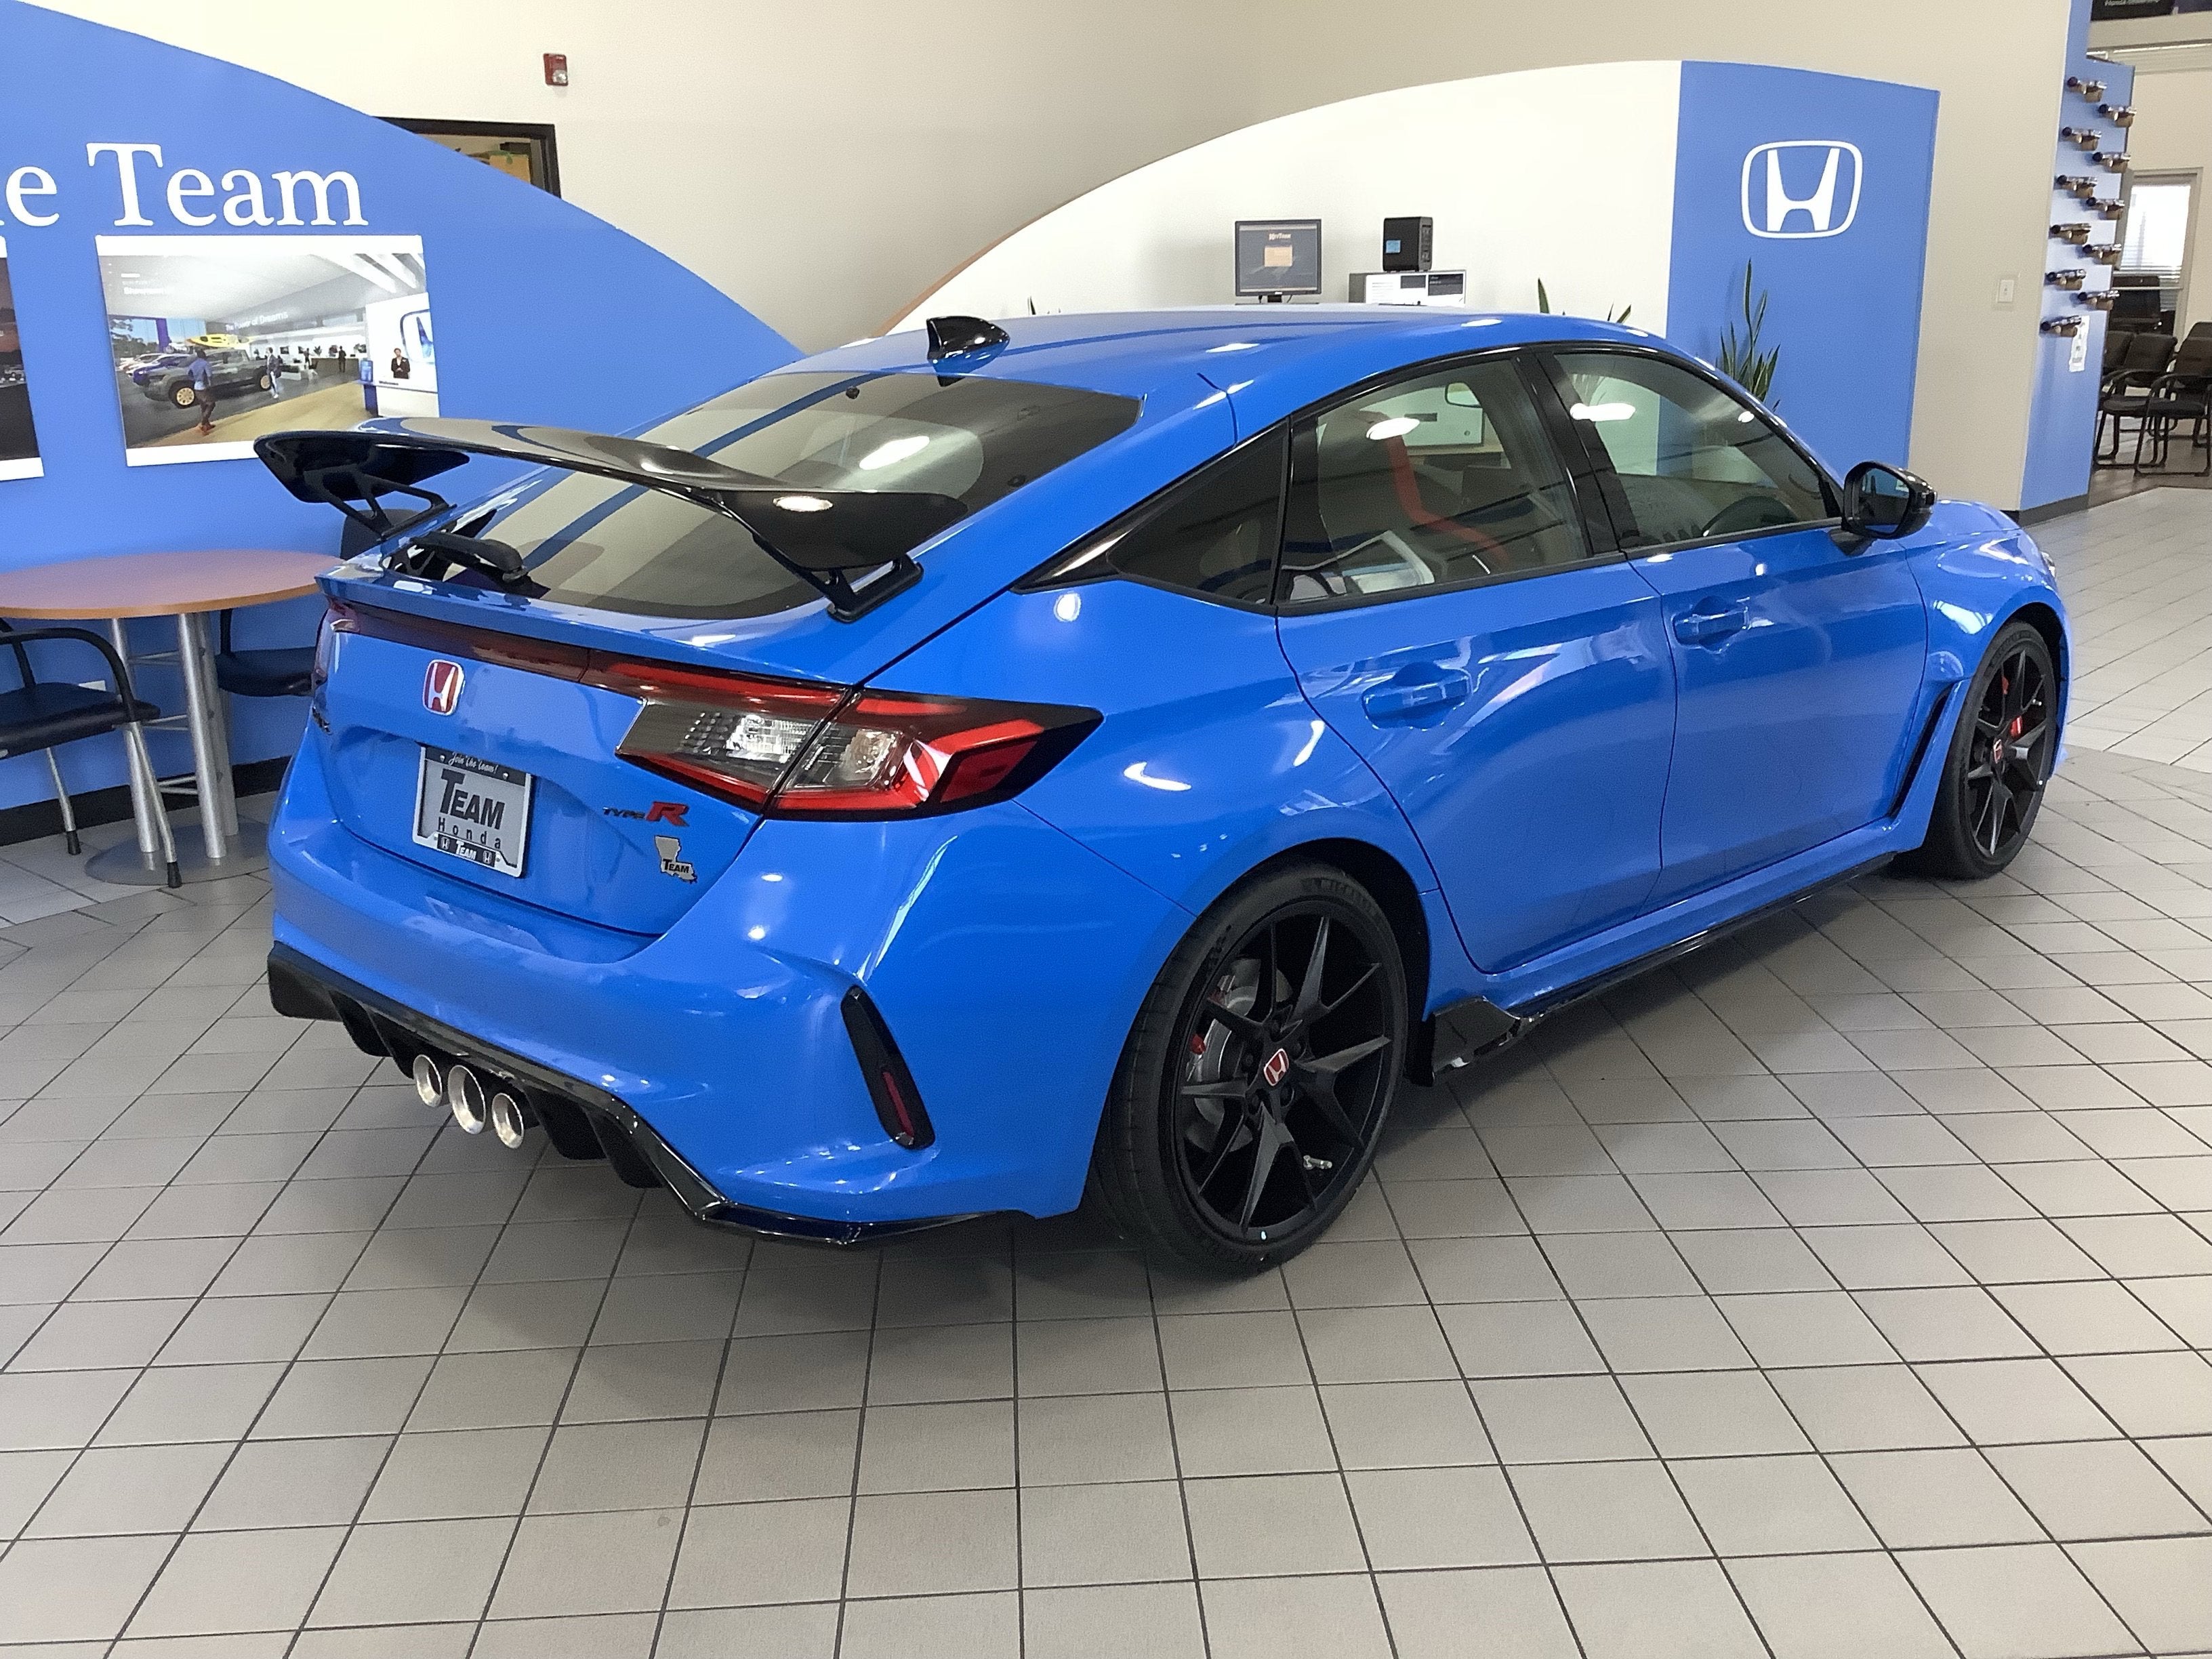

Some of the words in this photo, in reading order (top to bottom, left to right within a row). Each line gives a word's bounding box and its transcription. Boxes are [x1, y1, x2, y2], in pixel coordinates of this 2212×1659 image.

[0, 166, 60, 226] e
[86, 142, 369, 226] Team
[440, 768, 505, 830] TEAM
[438, 816, 501, 850] Honda
[455, 840, 477, 860] TEAM
[663, 858, 690, 874] TEAM
